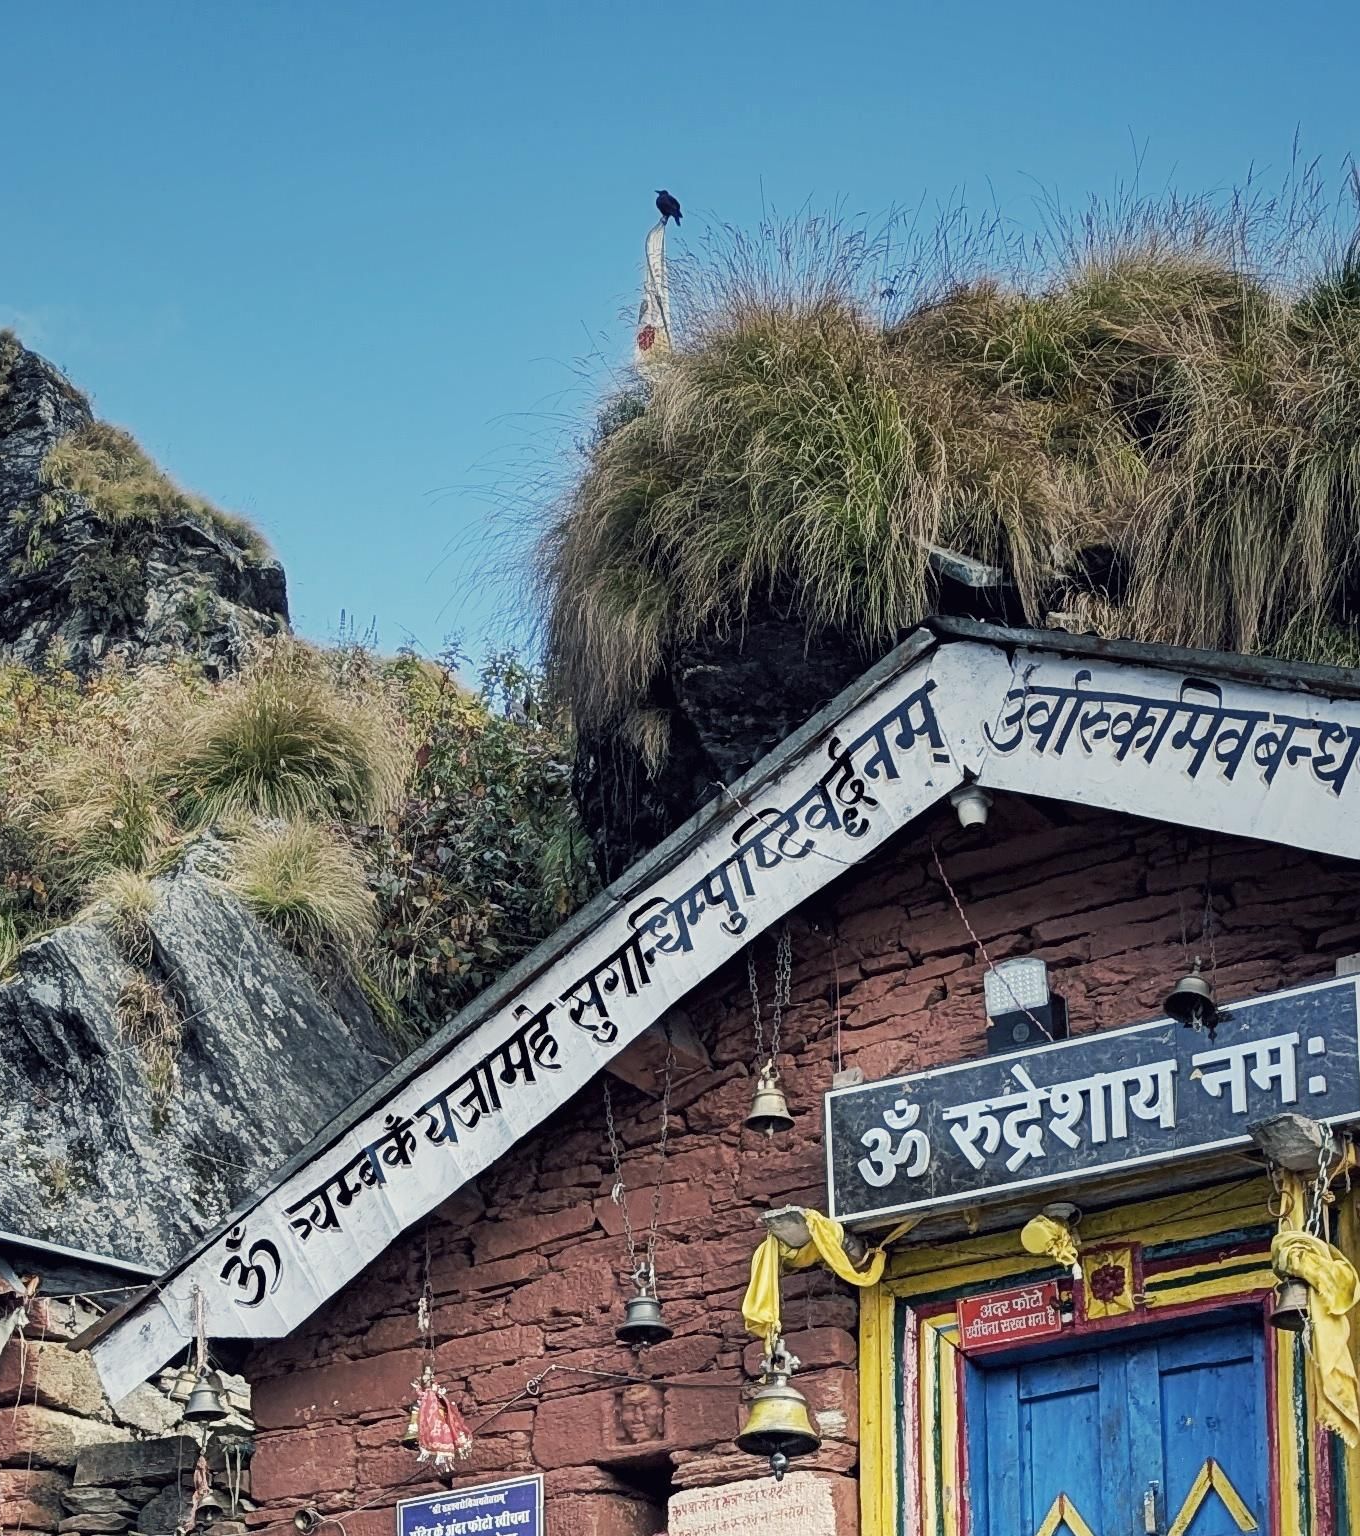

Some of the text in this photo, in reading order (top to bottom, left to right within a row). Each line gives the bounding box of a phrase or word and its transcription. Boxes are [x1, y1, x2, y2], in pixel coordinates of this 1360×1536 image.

[857, 1099, 931, 1188] ॐ
[980, 1289, 1043, 1318] अंदर फोटो
[1028, 1312, 1046, 1327] मना
[445, 1518, 468, 1536] अंदर
[467, 1513, 493, 1532] फोटो
